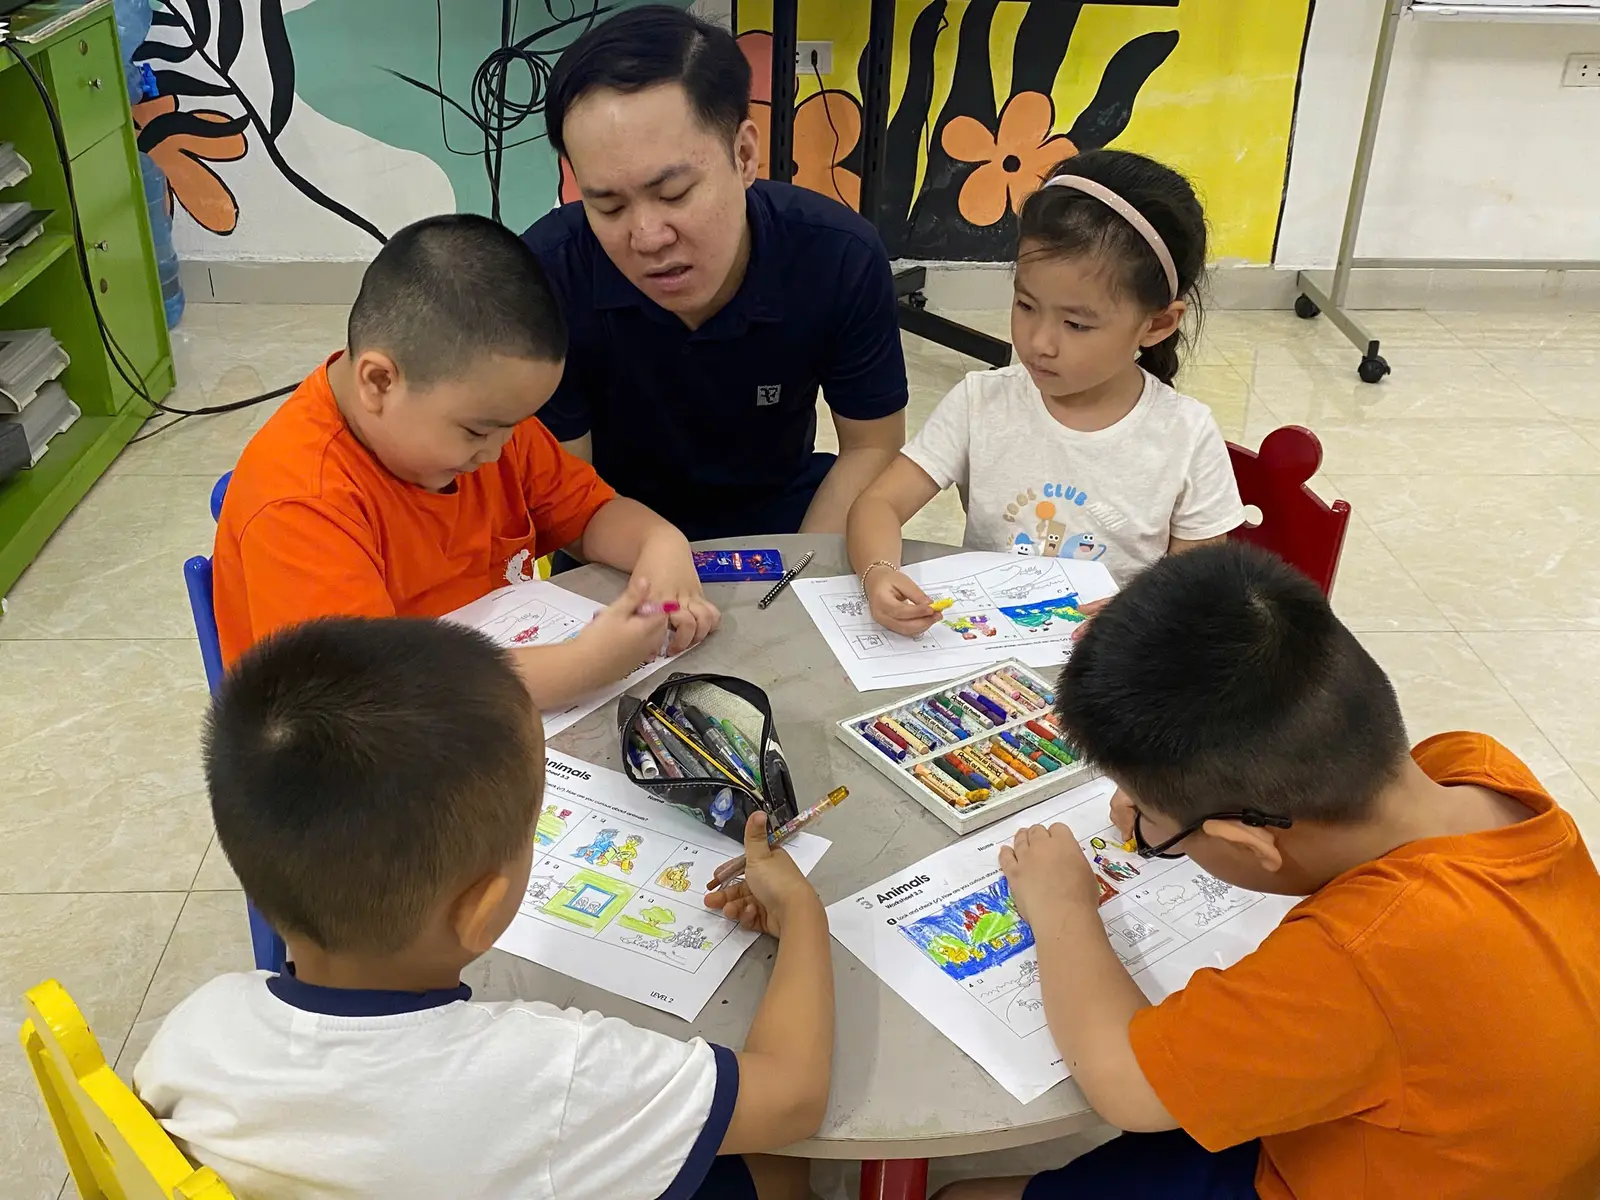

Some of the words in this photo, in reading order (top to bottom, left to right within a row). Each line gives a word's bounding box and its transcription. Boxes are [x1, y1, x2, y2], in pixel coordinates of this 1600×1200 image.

[1043, 483, 1087, 506] CLUB
[957, 751, 973, 766] Pentel
[864, 900, 874, 910] 3
[876, 875, 930, 904] Animals
[650, 991, 668, 1001] LEVEL
